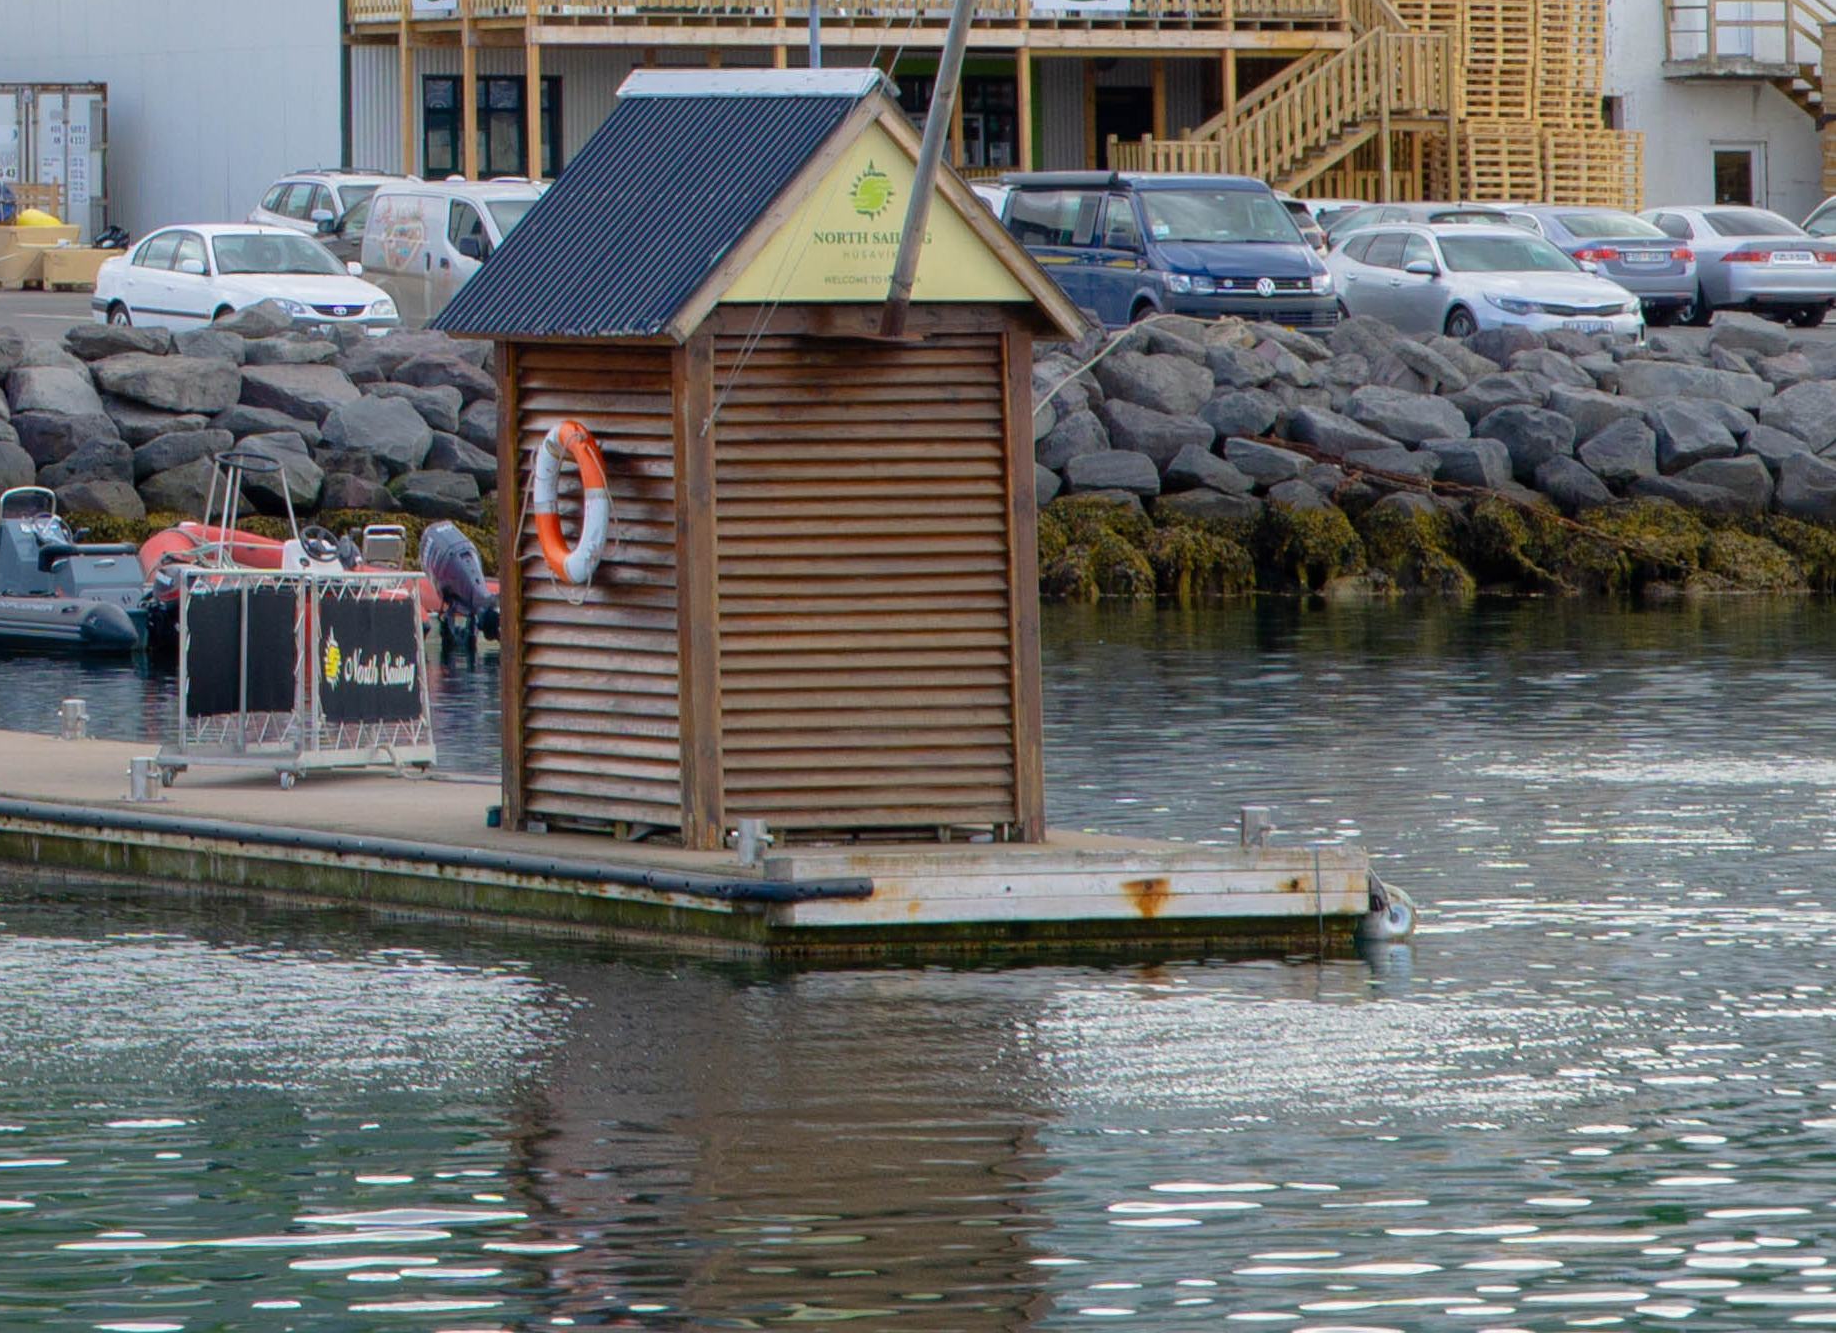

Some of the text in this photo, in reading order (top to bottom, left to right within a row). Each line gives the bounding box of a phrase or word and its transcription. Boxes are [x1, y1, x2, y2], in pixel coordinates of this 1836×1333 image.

[813, 232, 868, 245] NORTH
[345, 647, 416, 692] North Sailing
